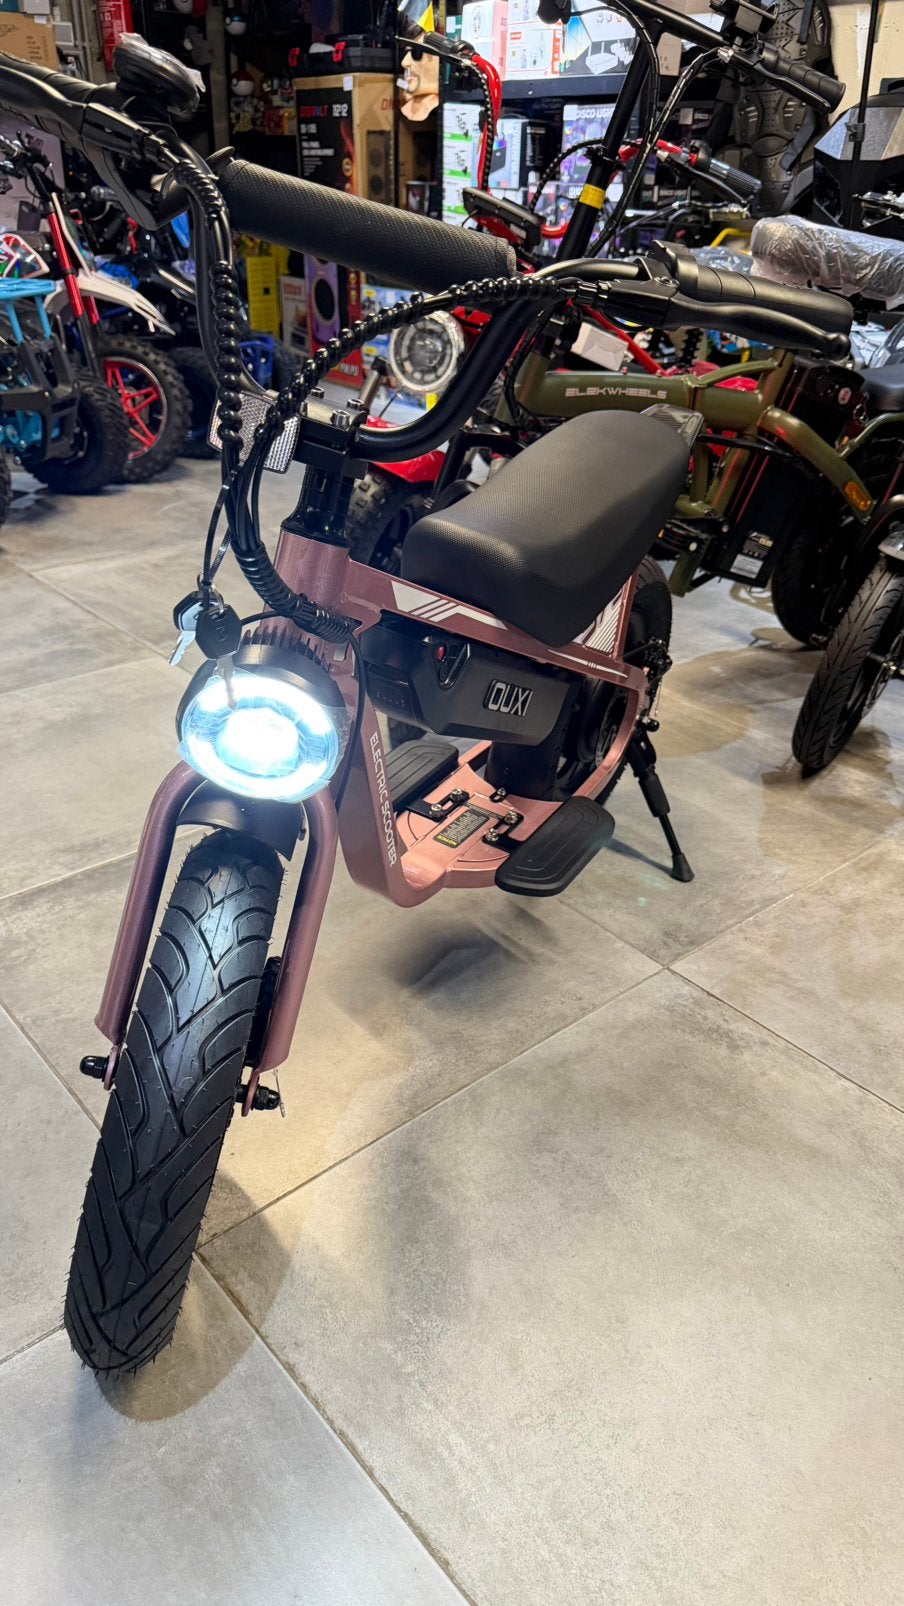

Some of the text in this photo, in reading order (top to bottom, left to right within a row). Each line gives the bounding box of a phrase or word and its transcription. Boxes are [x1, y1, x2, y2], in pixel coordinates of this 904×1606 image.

[596, 107, 614, 118] LIGH
[565, 387, 667, 400] ELEKWHEELS
[488, 682, 533, 716] OUXI
[370, 732, 397, 867] ELECTRIC SCOOTER
